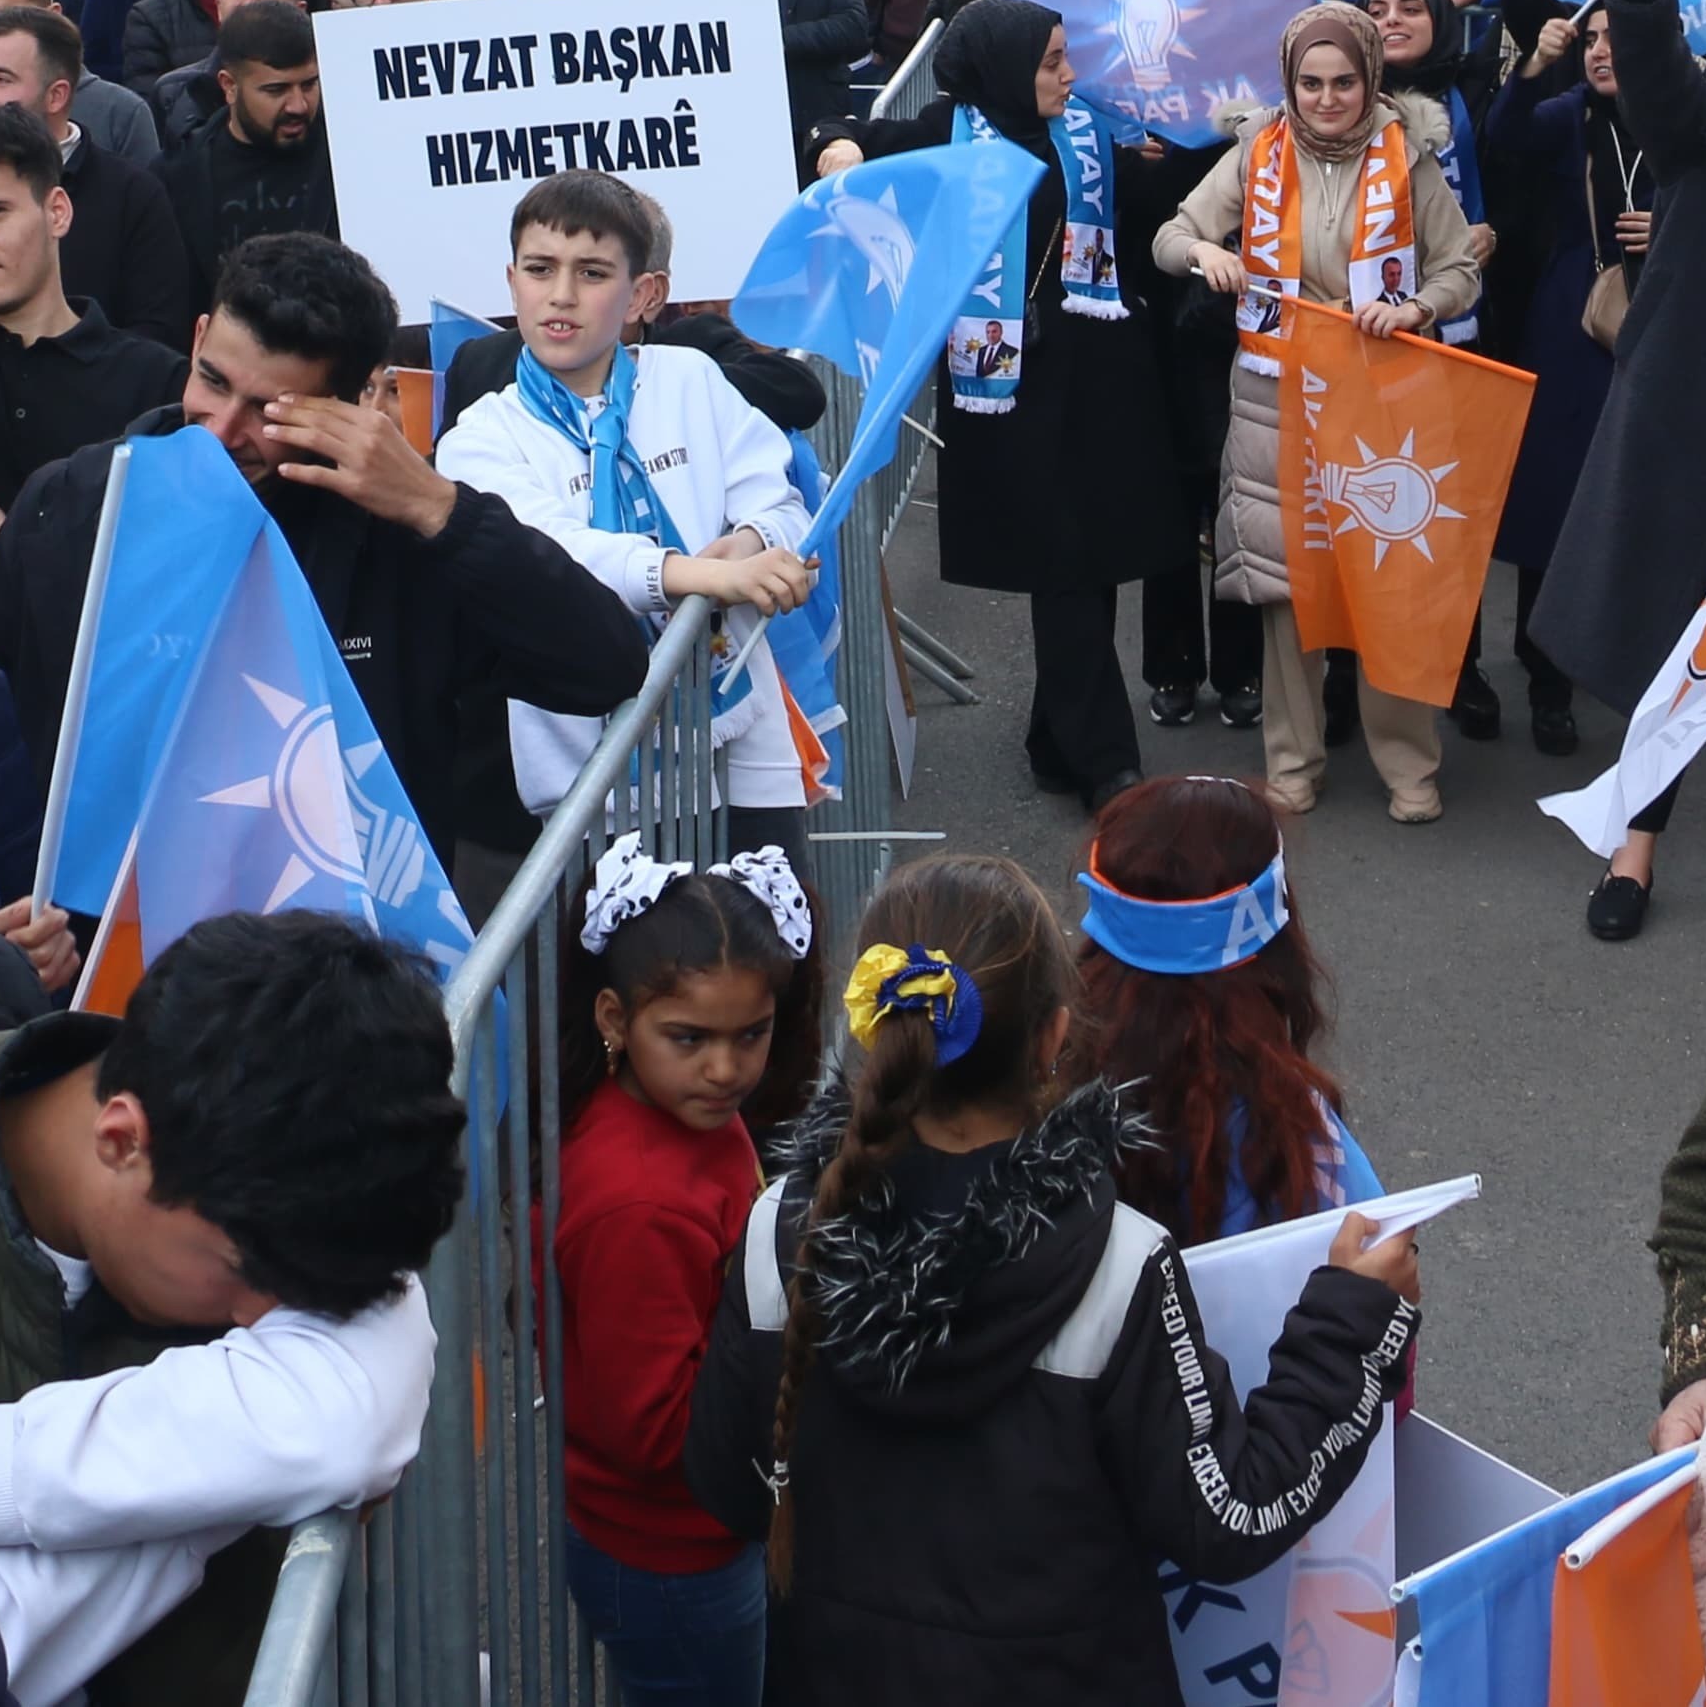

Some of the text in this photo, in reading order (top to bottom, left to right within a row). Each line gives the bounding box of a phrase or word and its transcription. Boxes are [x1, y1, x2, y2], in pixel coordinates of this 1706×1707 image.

[373, 20, 732, 101] NEVZAT BAŞKAN
[425, 98, 701, 187] HIZMETKARÊ
[1170, 1333, 1205, 1392] YOUR
